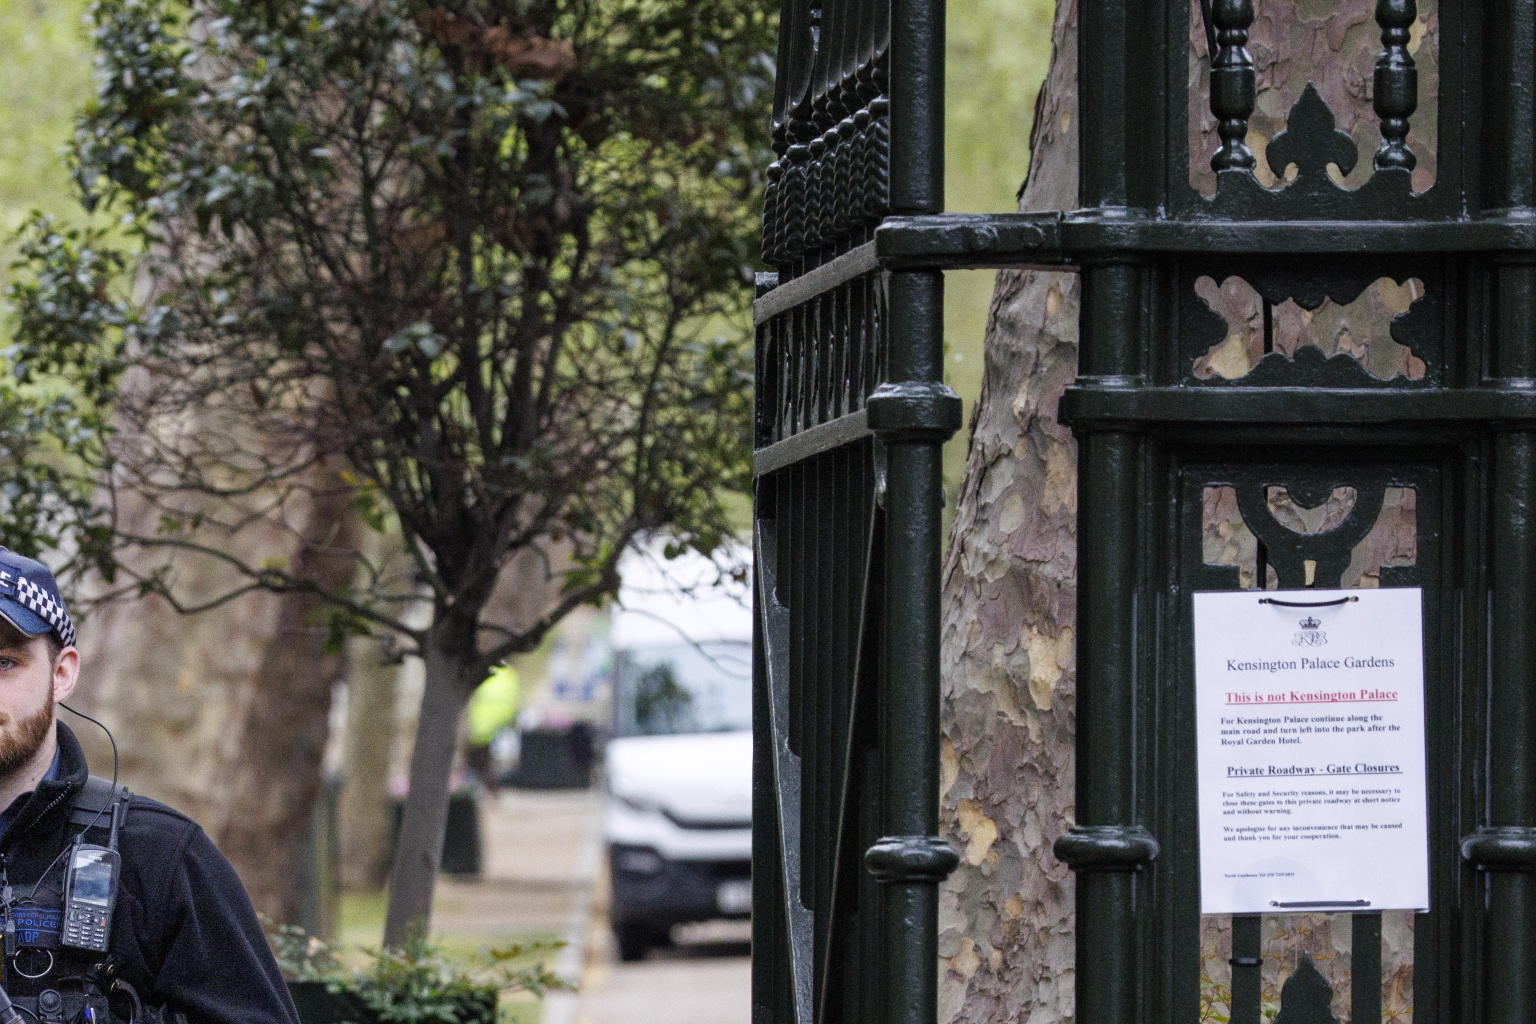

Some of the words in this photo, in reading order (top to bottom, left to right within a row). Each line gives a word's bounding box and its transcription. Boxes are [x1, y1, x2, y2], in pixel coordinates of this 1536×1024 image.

[1226, 659, 1297, 673] Kensington
[1301, 658, 1340, 670] Palace
[1344, 656, 1395, 668] Gardens
[1225, 692, 1252, 703] This
[1254, 692, 1264, 702] is
[1267, 692, 1286, 702] not
[1290, 690, 1356, 703] Kensington
[1360, 689, 1398, 700] Palace
[1221, 717, 1234, 725] For
[1237, 717, 1281, 725] Kensington
[1311, 715, 1345, 723] continue
[1347, 715, 1368, 723] along
[1346, 725, 1365, 734] park
[1388, 724, 1401, 732] the
[1221, 738, 1244, 747] Royal
[1246, 737, 1276, 745] Garden
[1227, 766, 1264, 776] Private
[1268, 765, 1316, 776] Roadway
[1326, 764, 1352, 773] Gate
[1354, 763, 1400, 773] Closures
[17, 918, 57, 929] POLICE
